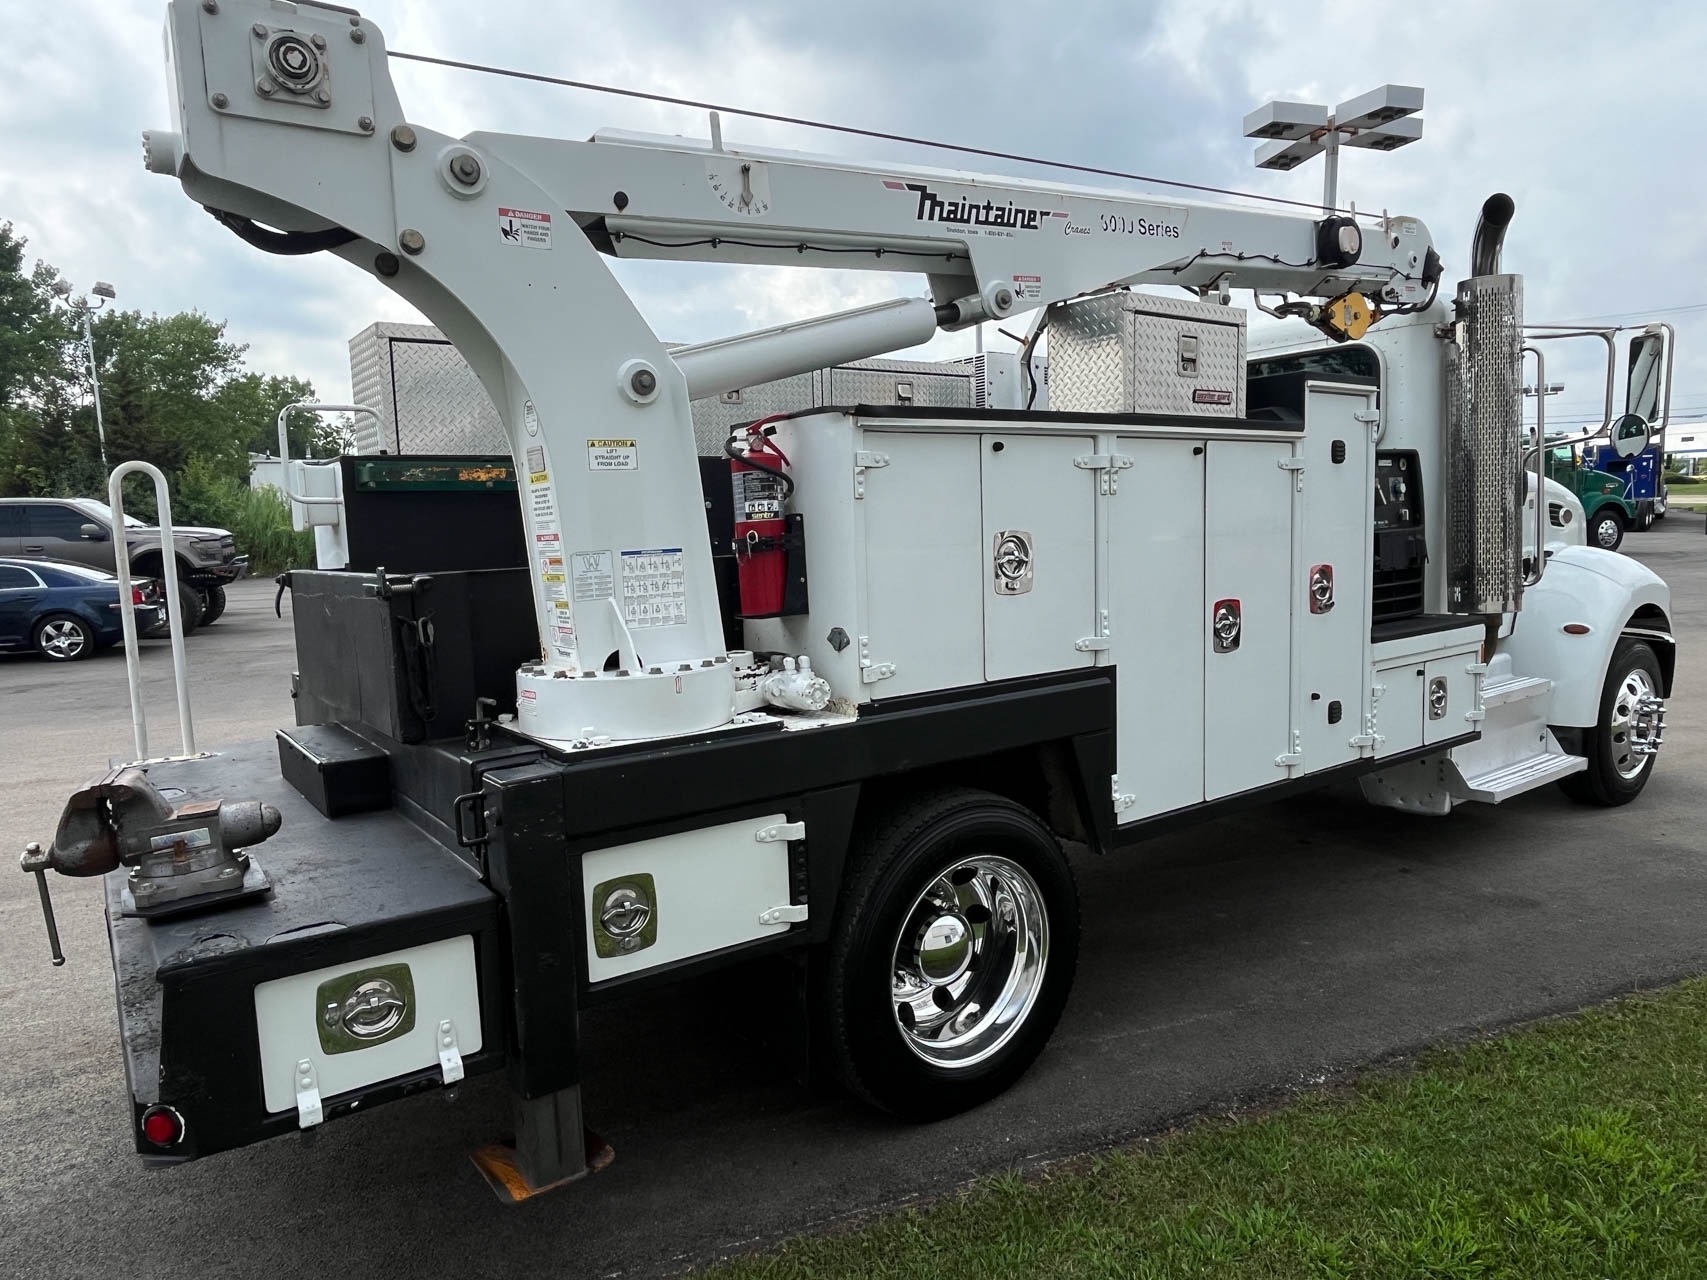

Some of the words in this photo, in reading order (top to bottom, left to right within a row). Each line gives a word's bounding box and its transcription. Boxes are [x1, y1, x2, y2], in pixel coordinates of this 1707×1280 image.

[905, 183, 1051, 230] Maintainer
[515, 211, 542, 220] DANGER
[1064, 220, 1091, 236] Cranes
[1138, 218, 1179, 238] Series
[751, 512, 774, 520] sentry
